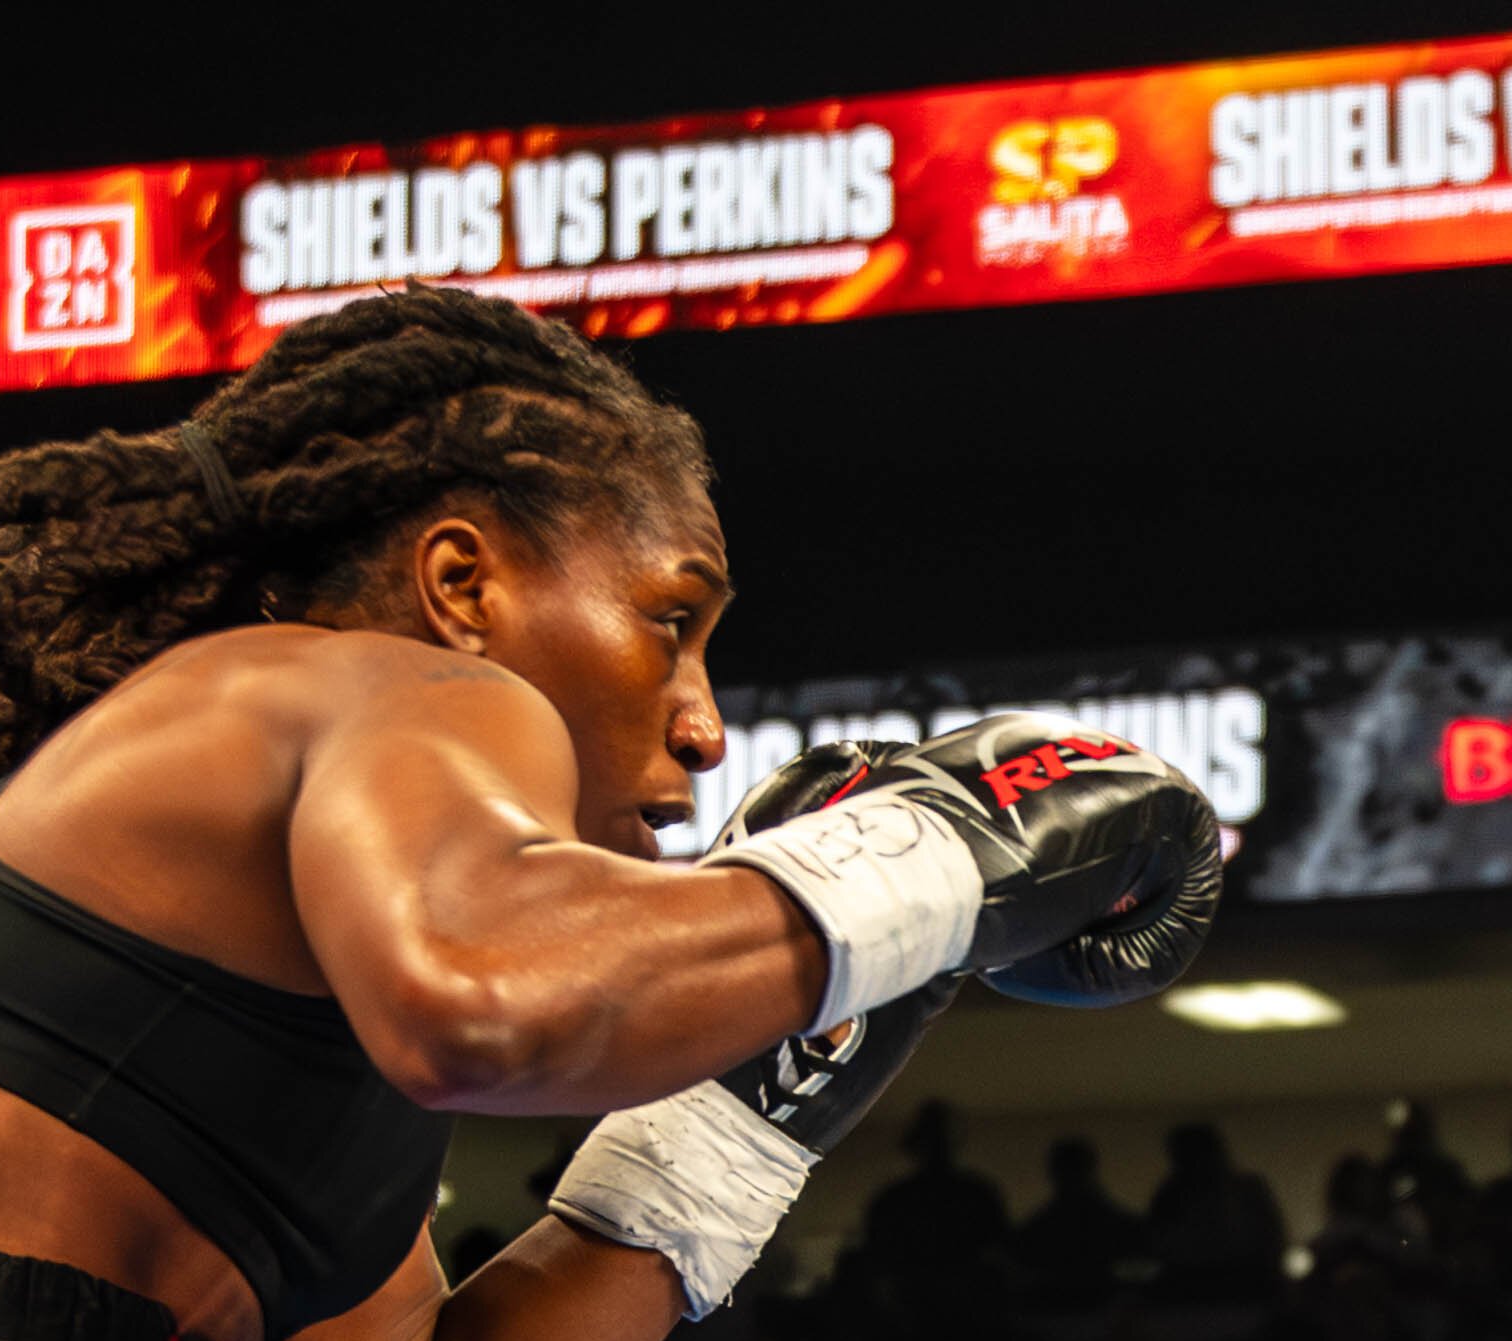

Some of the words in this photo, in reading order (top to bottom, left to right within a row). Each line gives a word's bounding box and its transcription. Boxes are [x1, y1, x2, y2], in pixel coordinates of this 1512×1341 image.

[1210, 69, 1496, 206] SHIELDS
[239, 164, 503, 296] SHIELDS
[509, 153, 608, 269] VS
[611, 124, 896, 263] PERKINS
[977, 198, 1130, 250] SALITA
